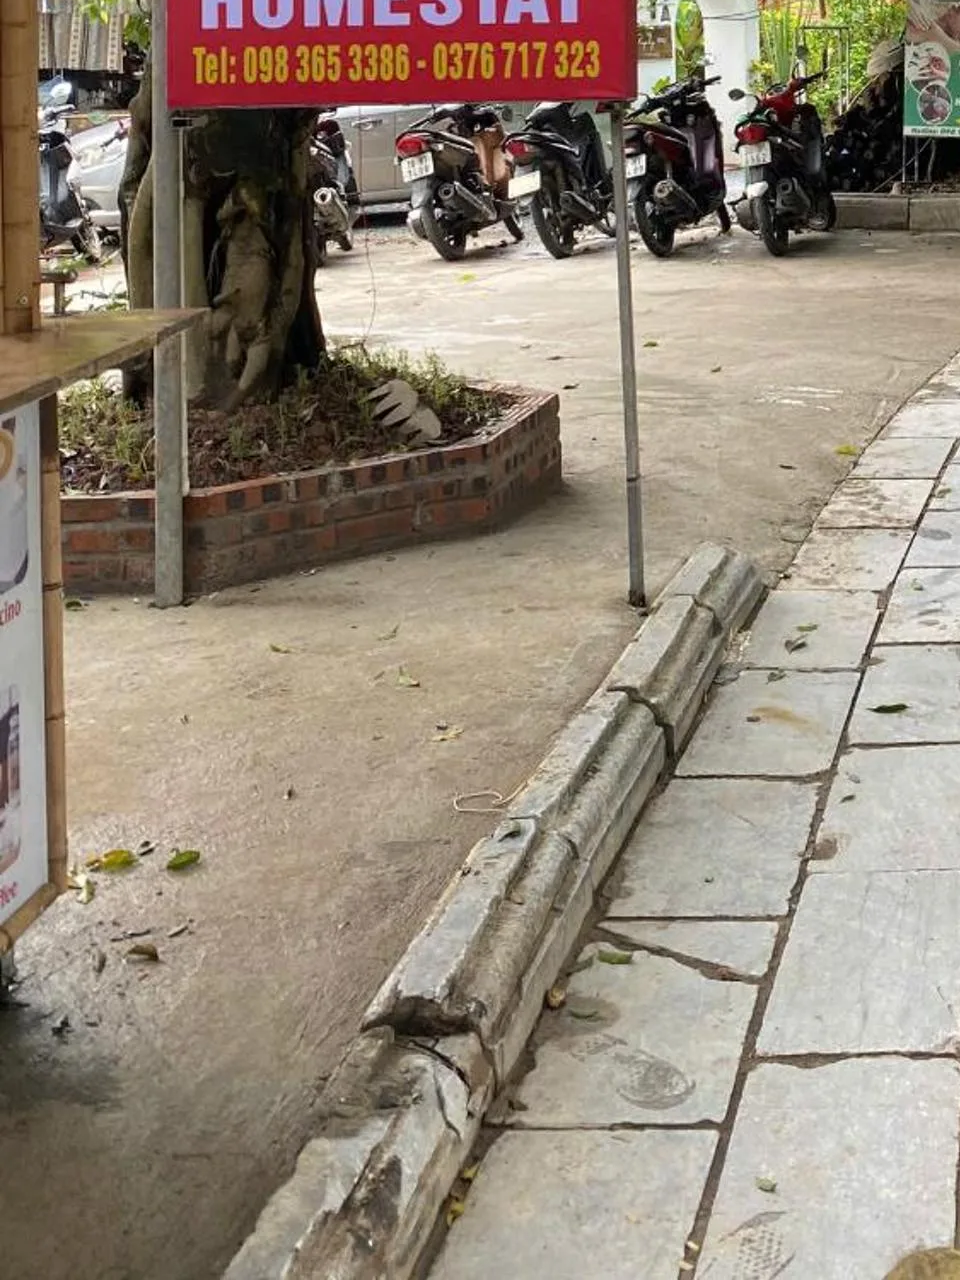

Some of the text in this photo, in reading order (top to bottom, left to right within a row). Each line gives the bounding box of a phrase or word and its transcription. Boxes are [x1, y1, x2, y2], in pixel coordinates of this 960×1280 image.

[193, 46, 237, 85] Tel:
[243, 45, 289, 84] 098
[295, 44, 342, 83] 365
[348, 42, 410, 82] 3386
[433, 41, 495, 80] 0376
[501, 41, 546, 79] 717
[554, 39, 601, 78] 323
